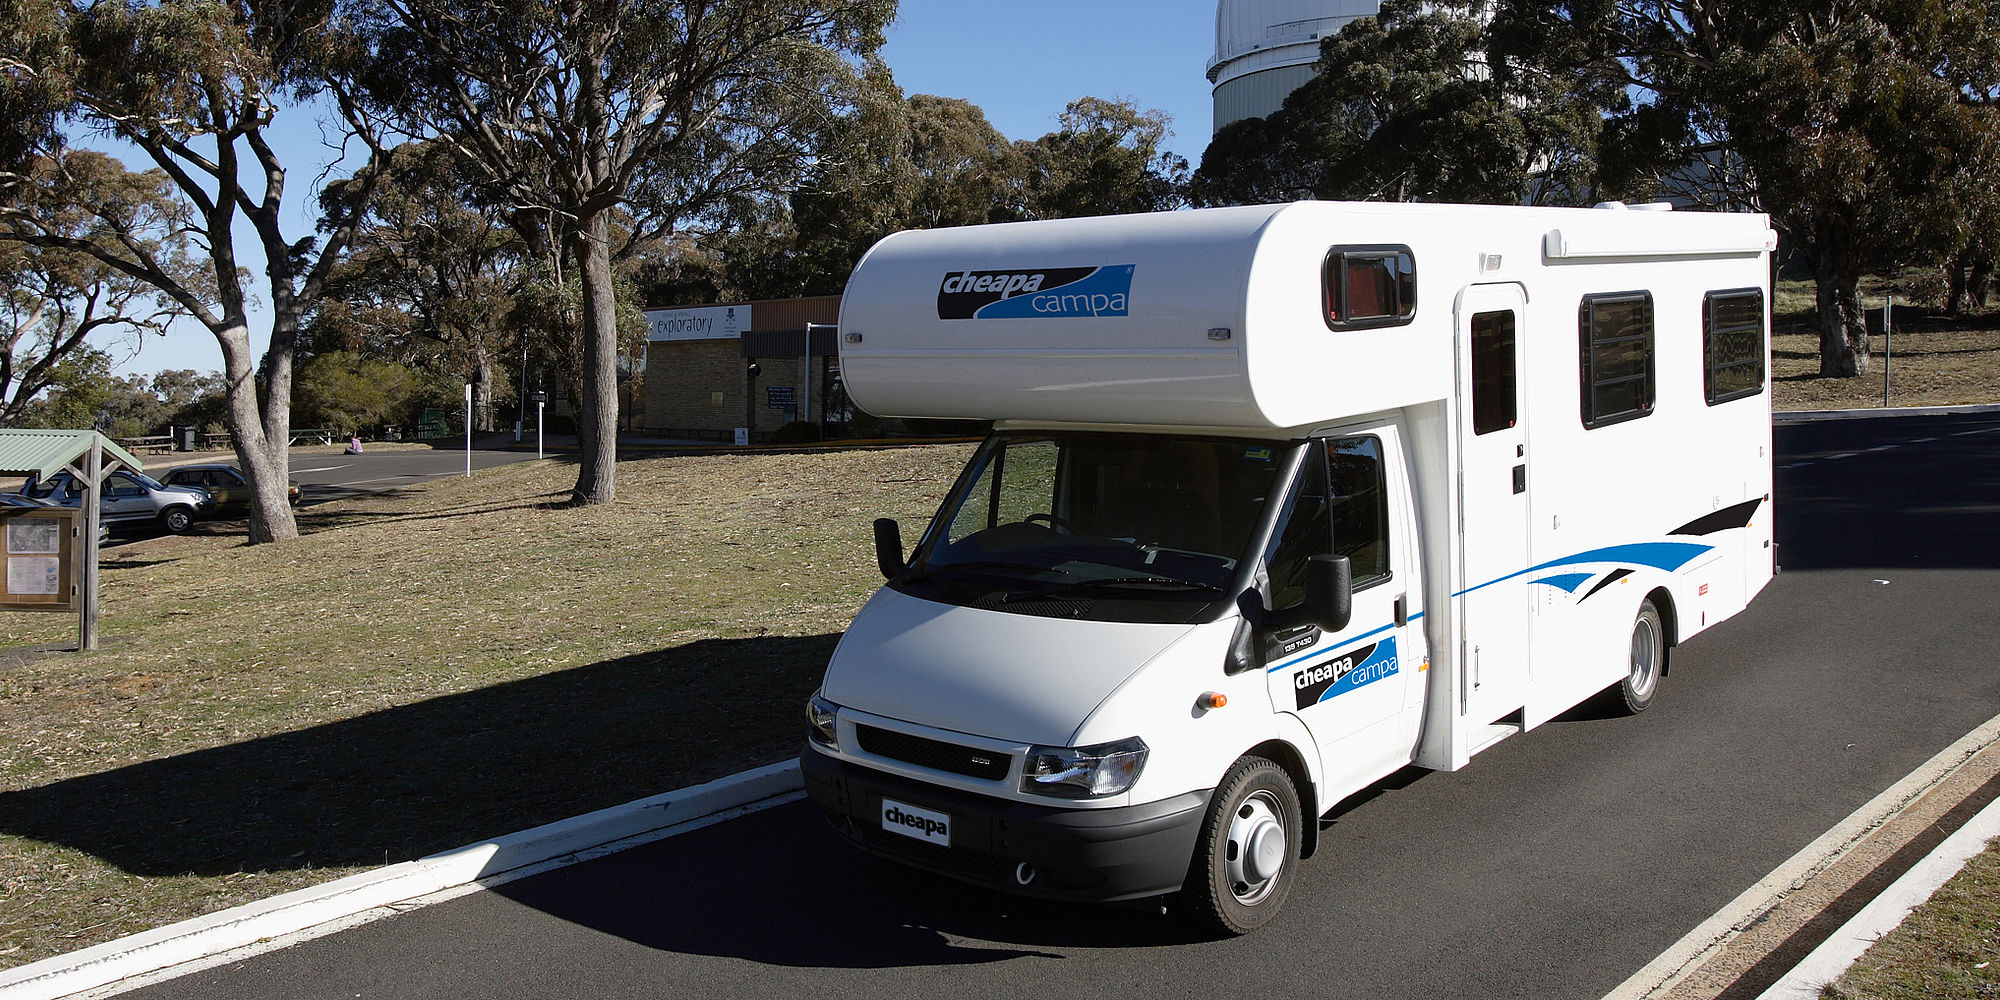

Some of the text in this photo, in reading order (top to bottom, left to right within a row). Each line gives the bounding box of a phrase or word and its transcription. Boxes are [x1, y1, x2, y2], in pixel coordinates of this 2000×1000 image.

[943, 271, 1045, 300] cheapa
[1031, 293, 1126, 318] campa
[657, 313, 713, 337] exploratory
[1295, 656, 1353, 690] cheapa
[1351, 656, 1398, 685] campa
[885, 806, 947, 837] cheapa
